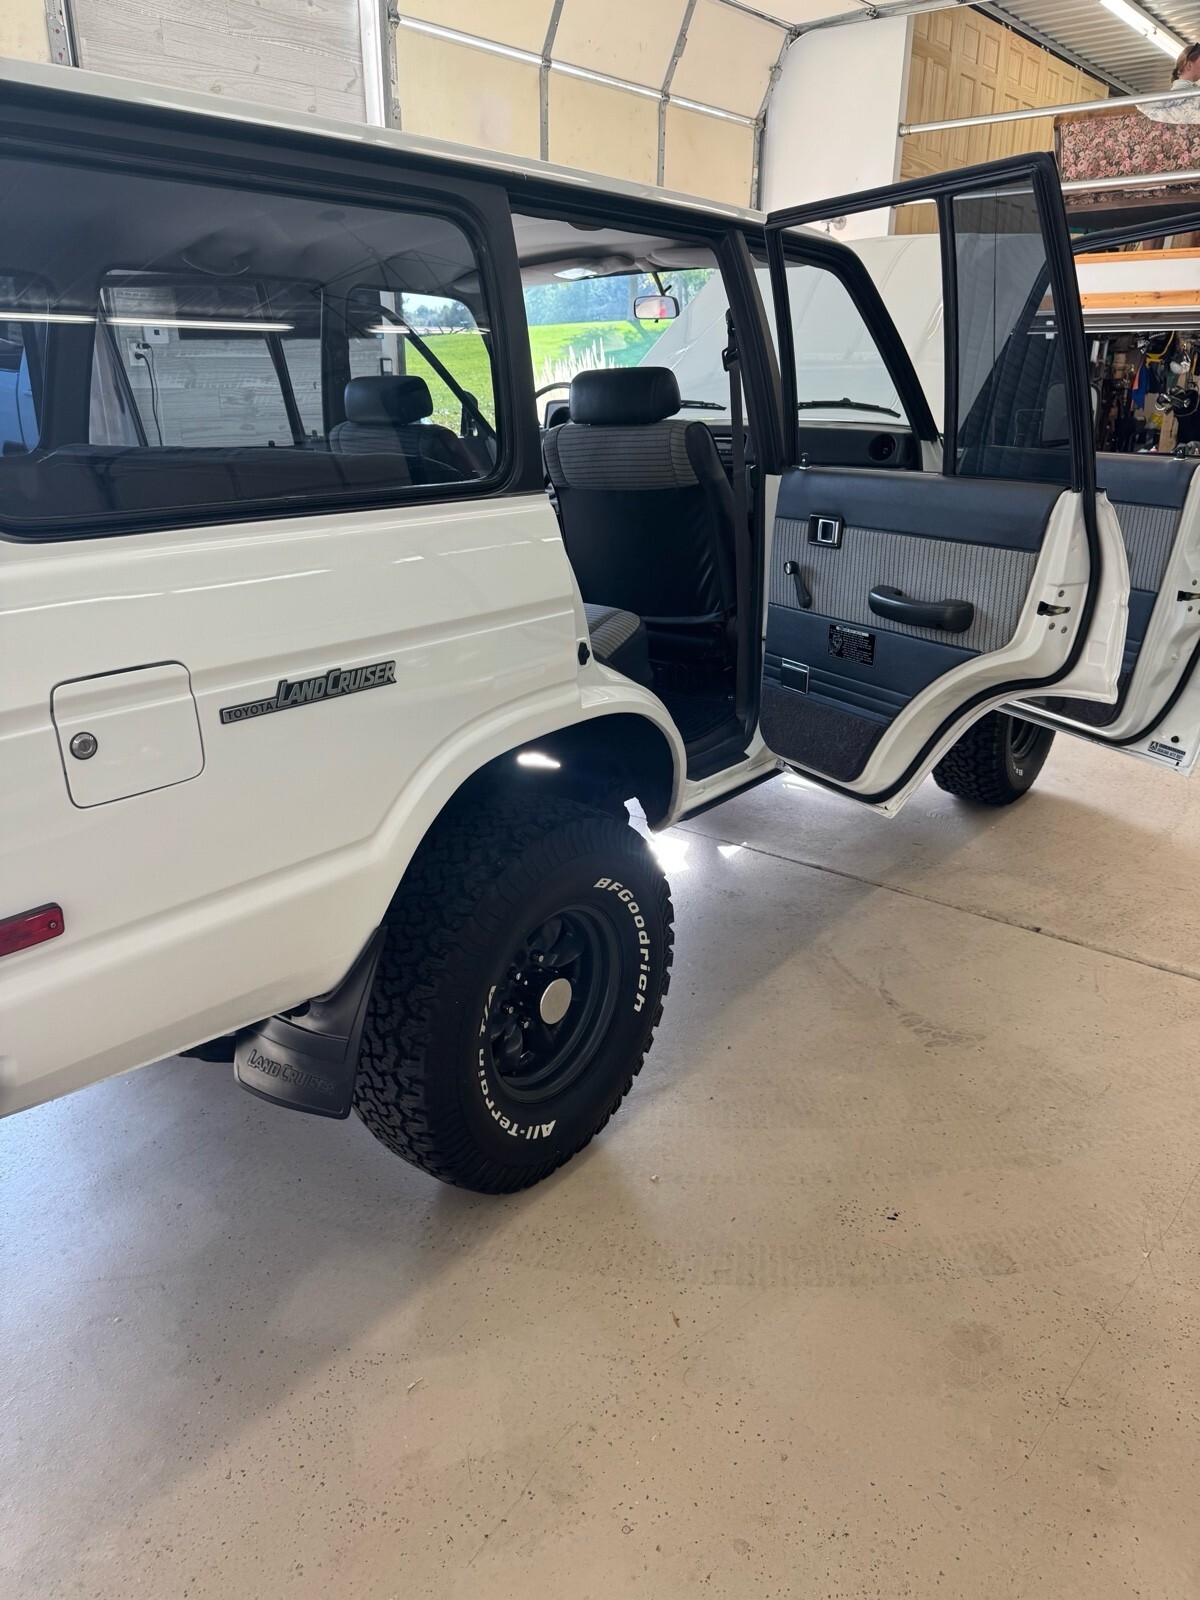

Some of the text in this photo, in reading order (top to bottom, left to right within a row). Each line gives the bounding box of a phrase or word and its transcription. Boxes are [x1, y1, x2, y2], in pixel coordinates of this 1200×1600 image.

[225, 701, 274, 721] TOYOTA
[593, 877, 651, 1013] BFGoodrich
[247, 1049, 337, 1095] LAND CRUISER
[478, 1048, 557, 1140] All-Terrain
